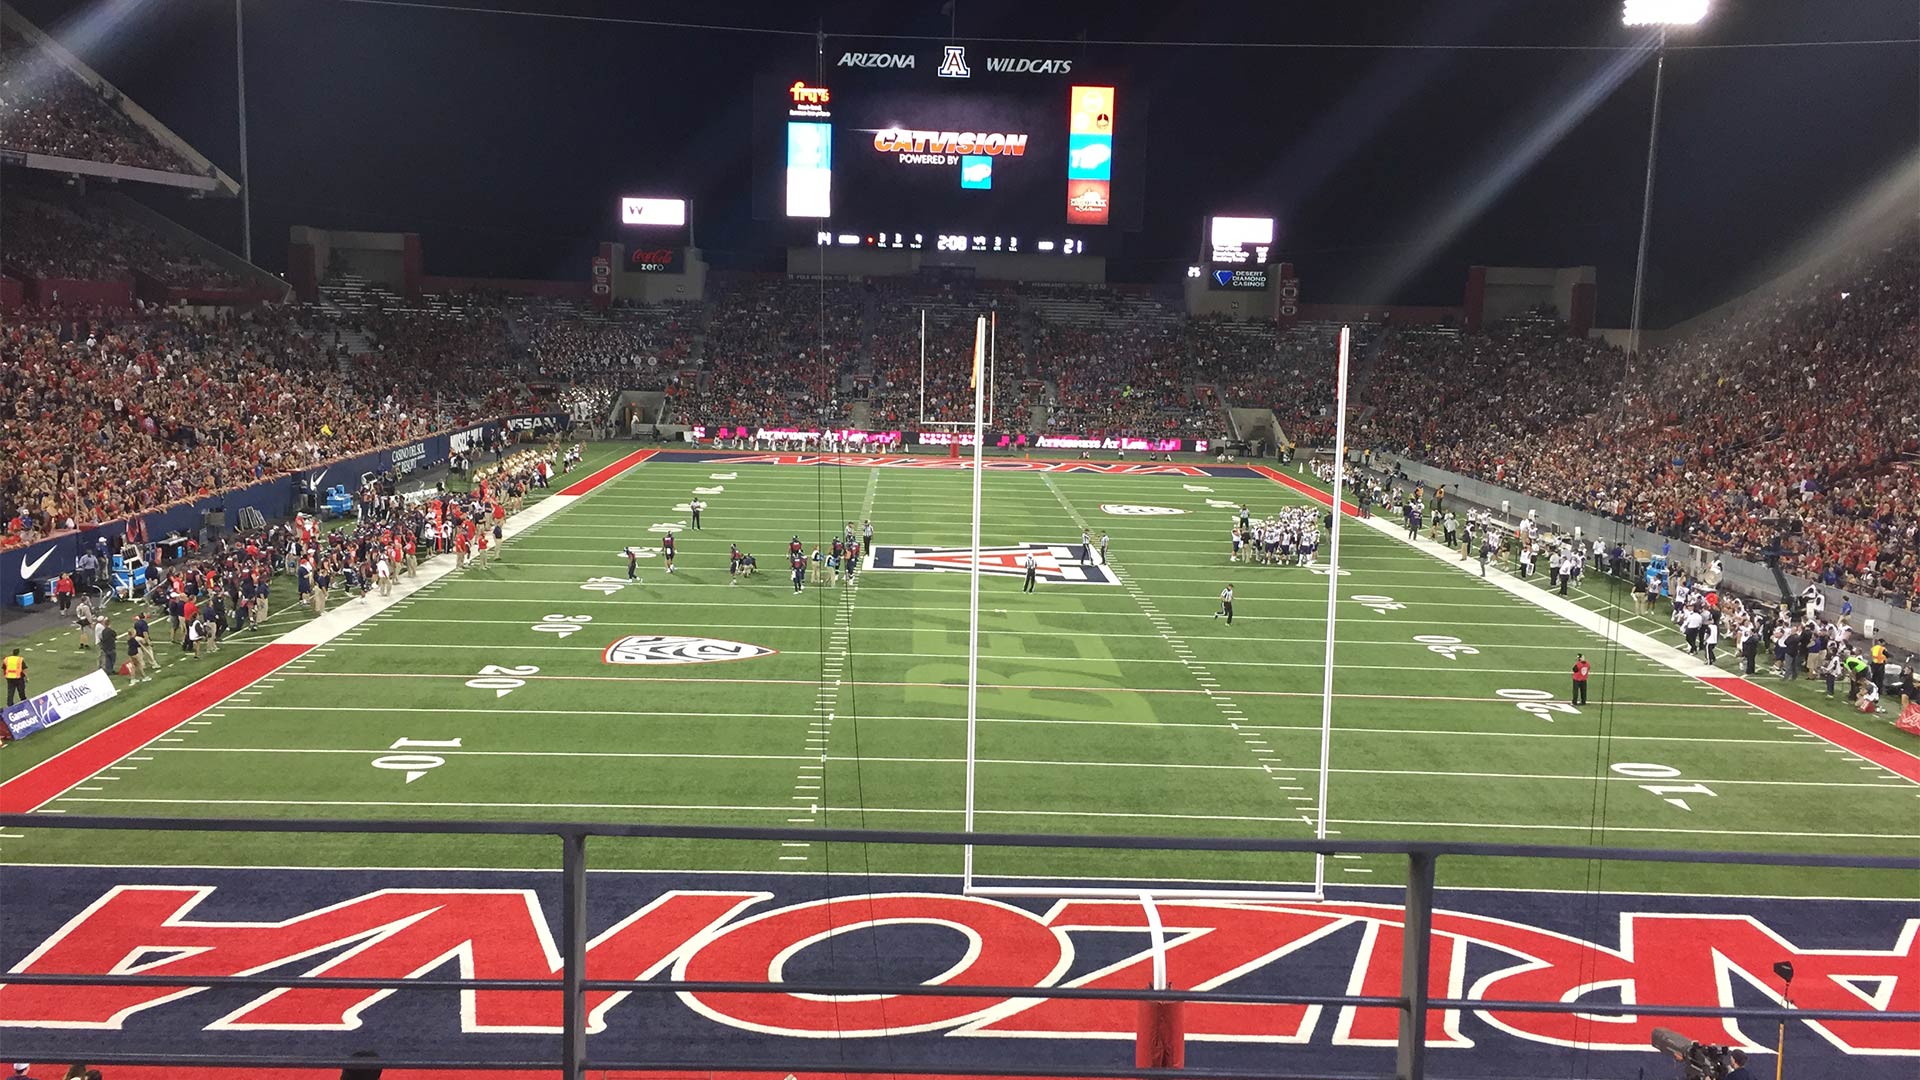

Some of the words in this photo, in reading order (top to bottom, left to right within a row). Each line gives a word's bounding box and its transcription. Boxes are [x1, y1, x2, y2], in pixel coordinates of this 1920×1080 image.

[837, 52, 916, 69] ARIZONA
[938, 45, 971, 78] A
[986, 57, 1073, 74] WILDCATS
[874, 128, 1029, 156] CATVISION
[899, 153, 946, 165] POWERED
[947, 154, 960, 165] BY
[1063, 238, 1083, 254] 21
[641, 263, 664, 271] zero
[507, 417, 557, 431] NISSAN
[531, 614, 593, 632] 30
[1413, 635, 1480, 655] 30
[465, 664, 540, 689] 20
[52, 682, 92, 707] Hughes
[1495, 688, 1582, 715] 20
[8, 707, 30, 723] Game
[9, 715, 39, 734] Sponsor
[371, 736, 462, 770] 10
[1610, 762, 1718, 797] 10
